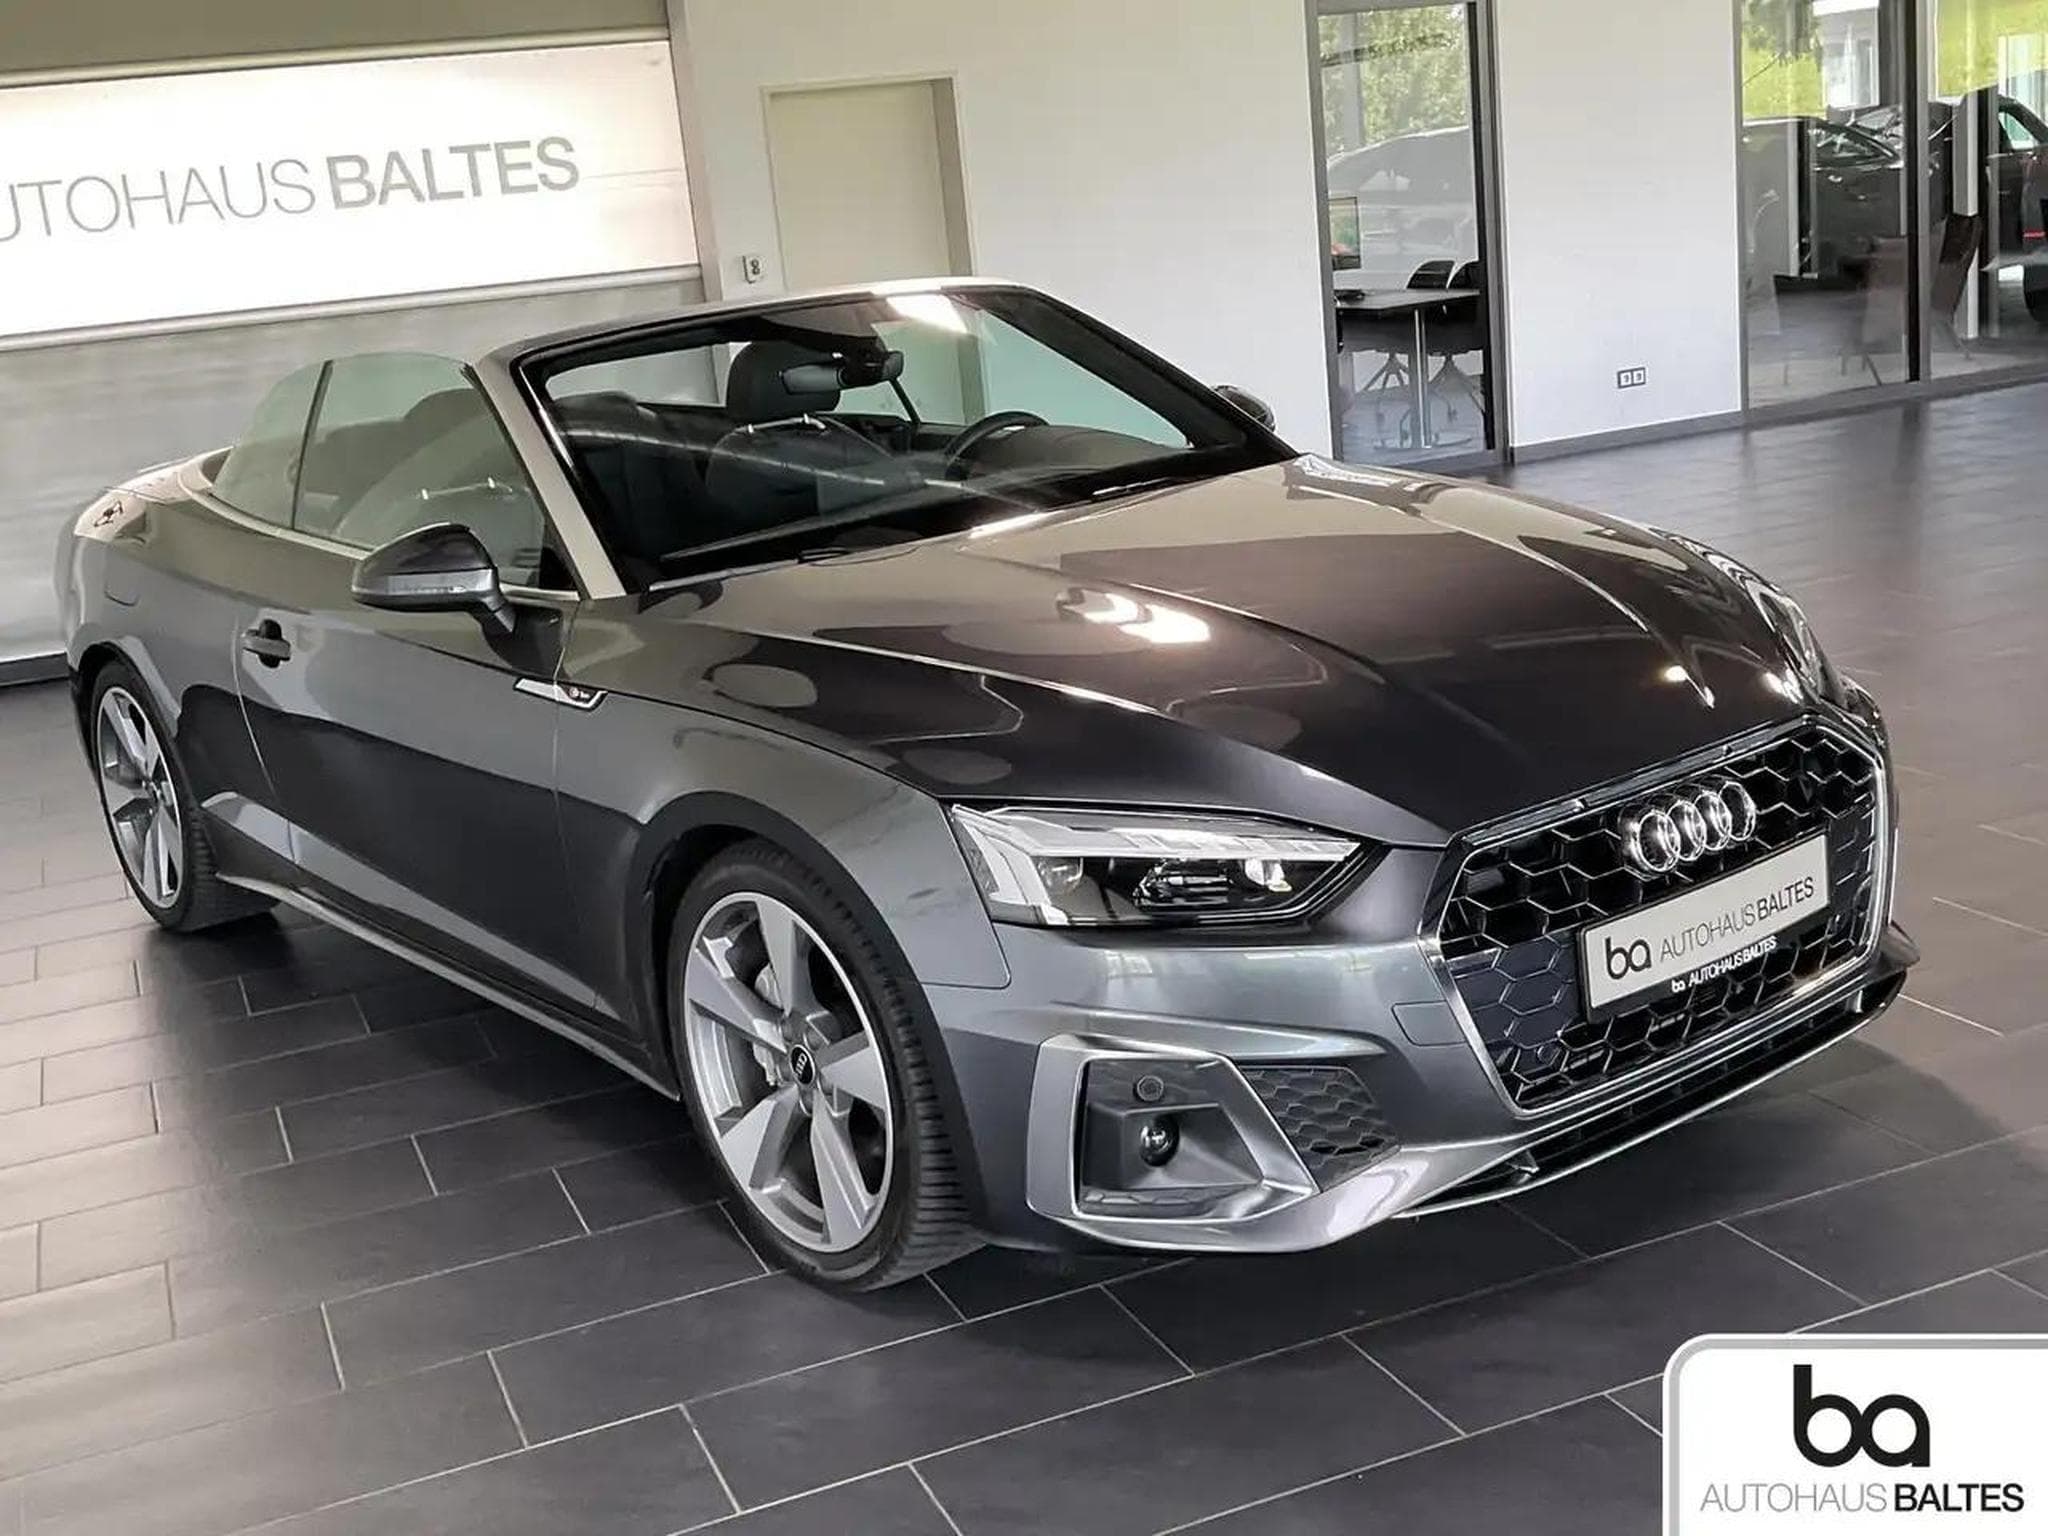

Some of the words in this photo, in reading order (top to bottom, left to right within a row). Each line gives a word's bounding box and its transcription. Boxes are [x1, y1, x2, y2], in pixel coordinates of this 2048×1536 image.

[326, 136, 580, 210] BALTES
[1605, 937, 1652, 980] ba
[1659, 903, 1756, 962] AUTOHAUS
[1757, 876, 1815, 921] BALTES
[1688, 952, 1743, 987] AUTOHAUS
[1743, 935, 1777, 962] BALTES
